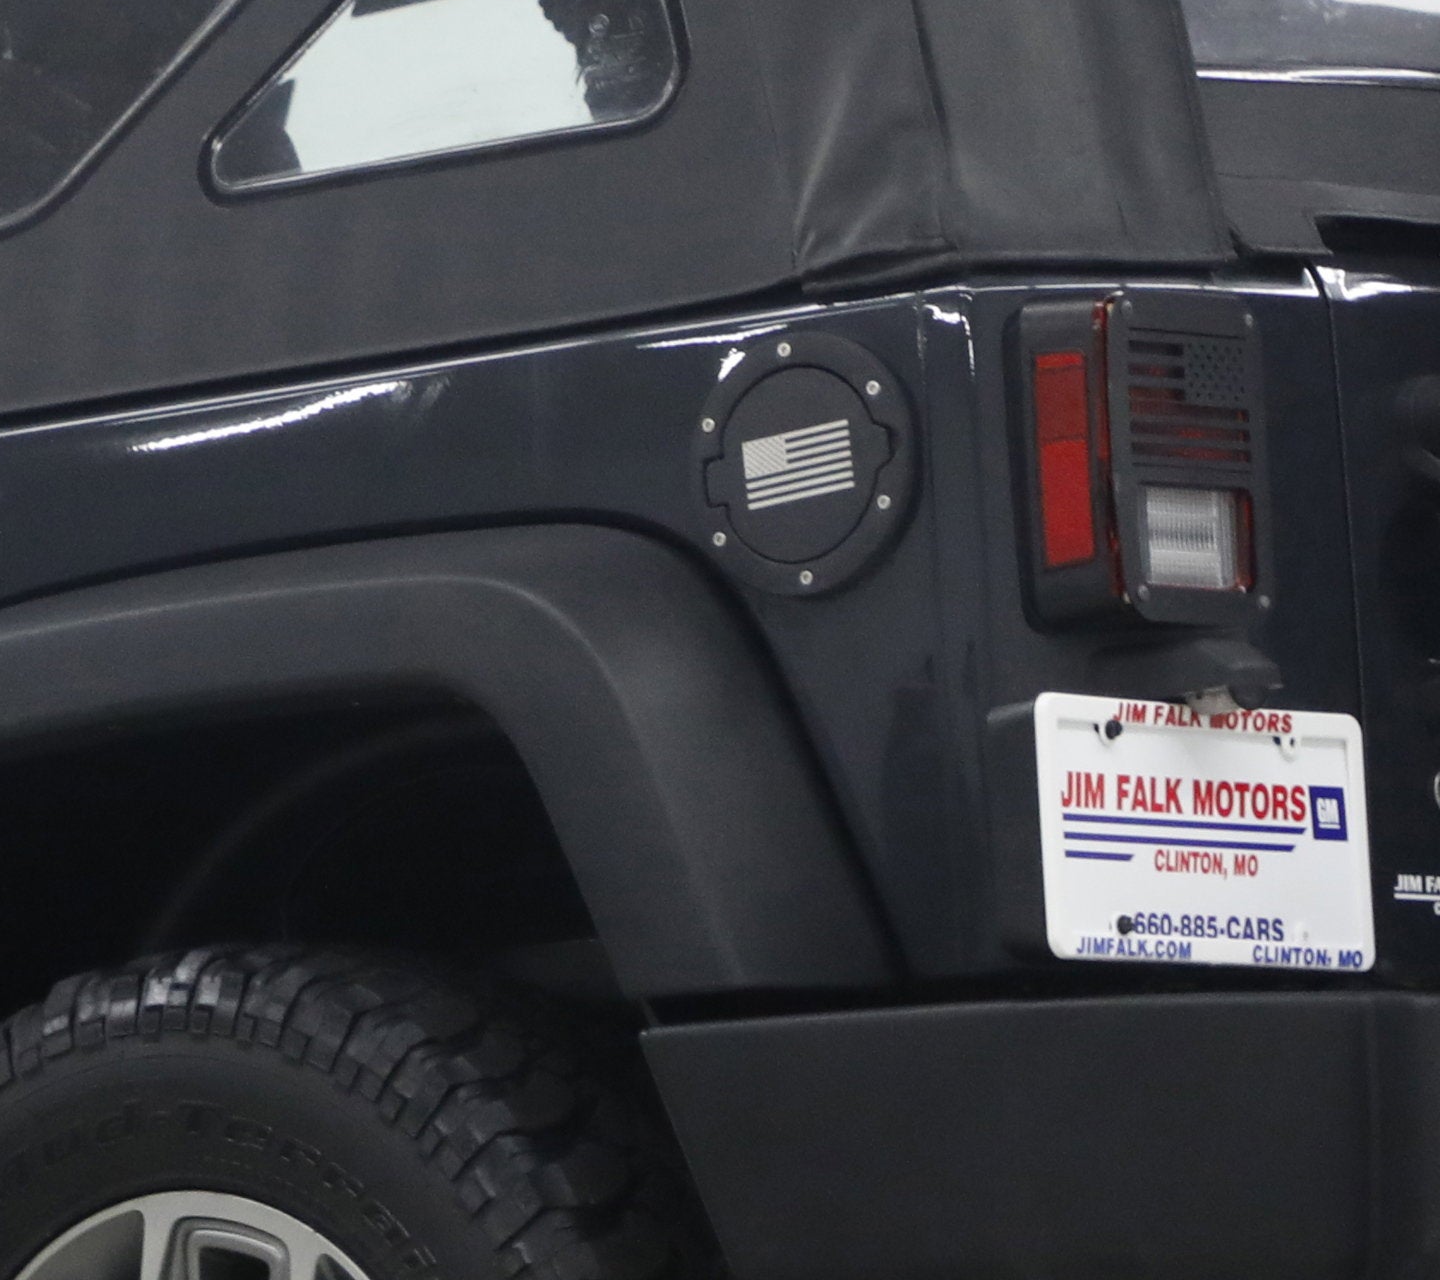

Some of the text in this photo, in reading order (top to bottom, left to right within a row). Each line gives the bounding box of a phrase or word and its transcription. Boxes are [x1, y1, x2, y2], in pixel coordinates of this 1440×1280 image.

[1112, 702, 1293, 734] JIM FALK MOTORS
[1061, 771, 1307, 823] JIM FALK MOTORS
[1154, 849, 1259, 880] CLINTON, MO
[1393, 874, 1423, 892] JIM
[1076, 937, 1192, 960] JIMFALK.COM
[1337, 950, 1364, 969] MO
